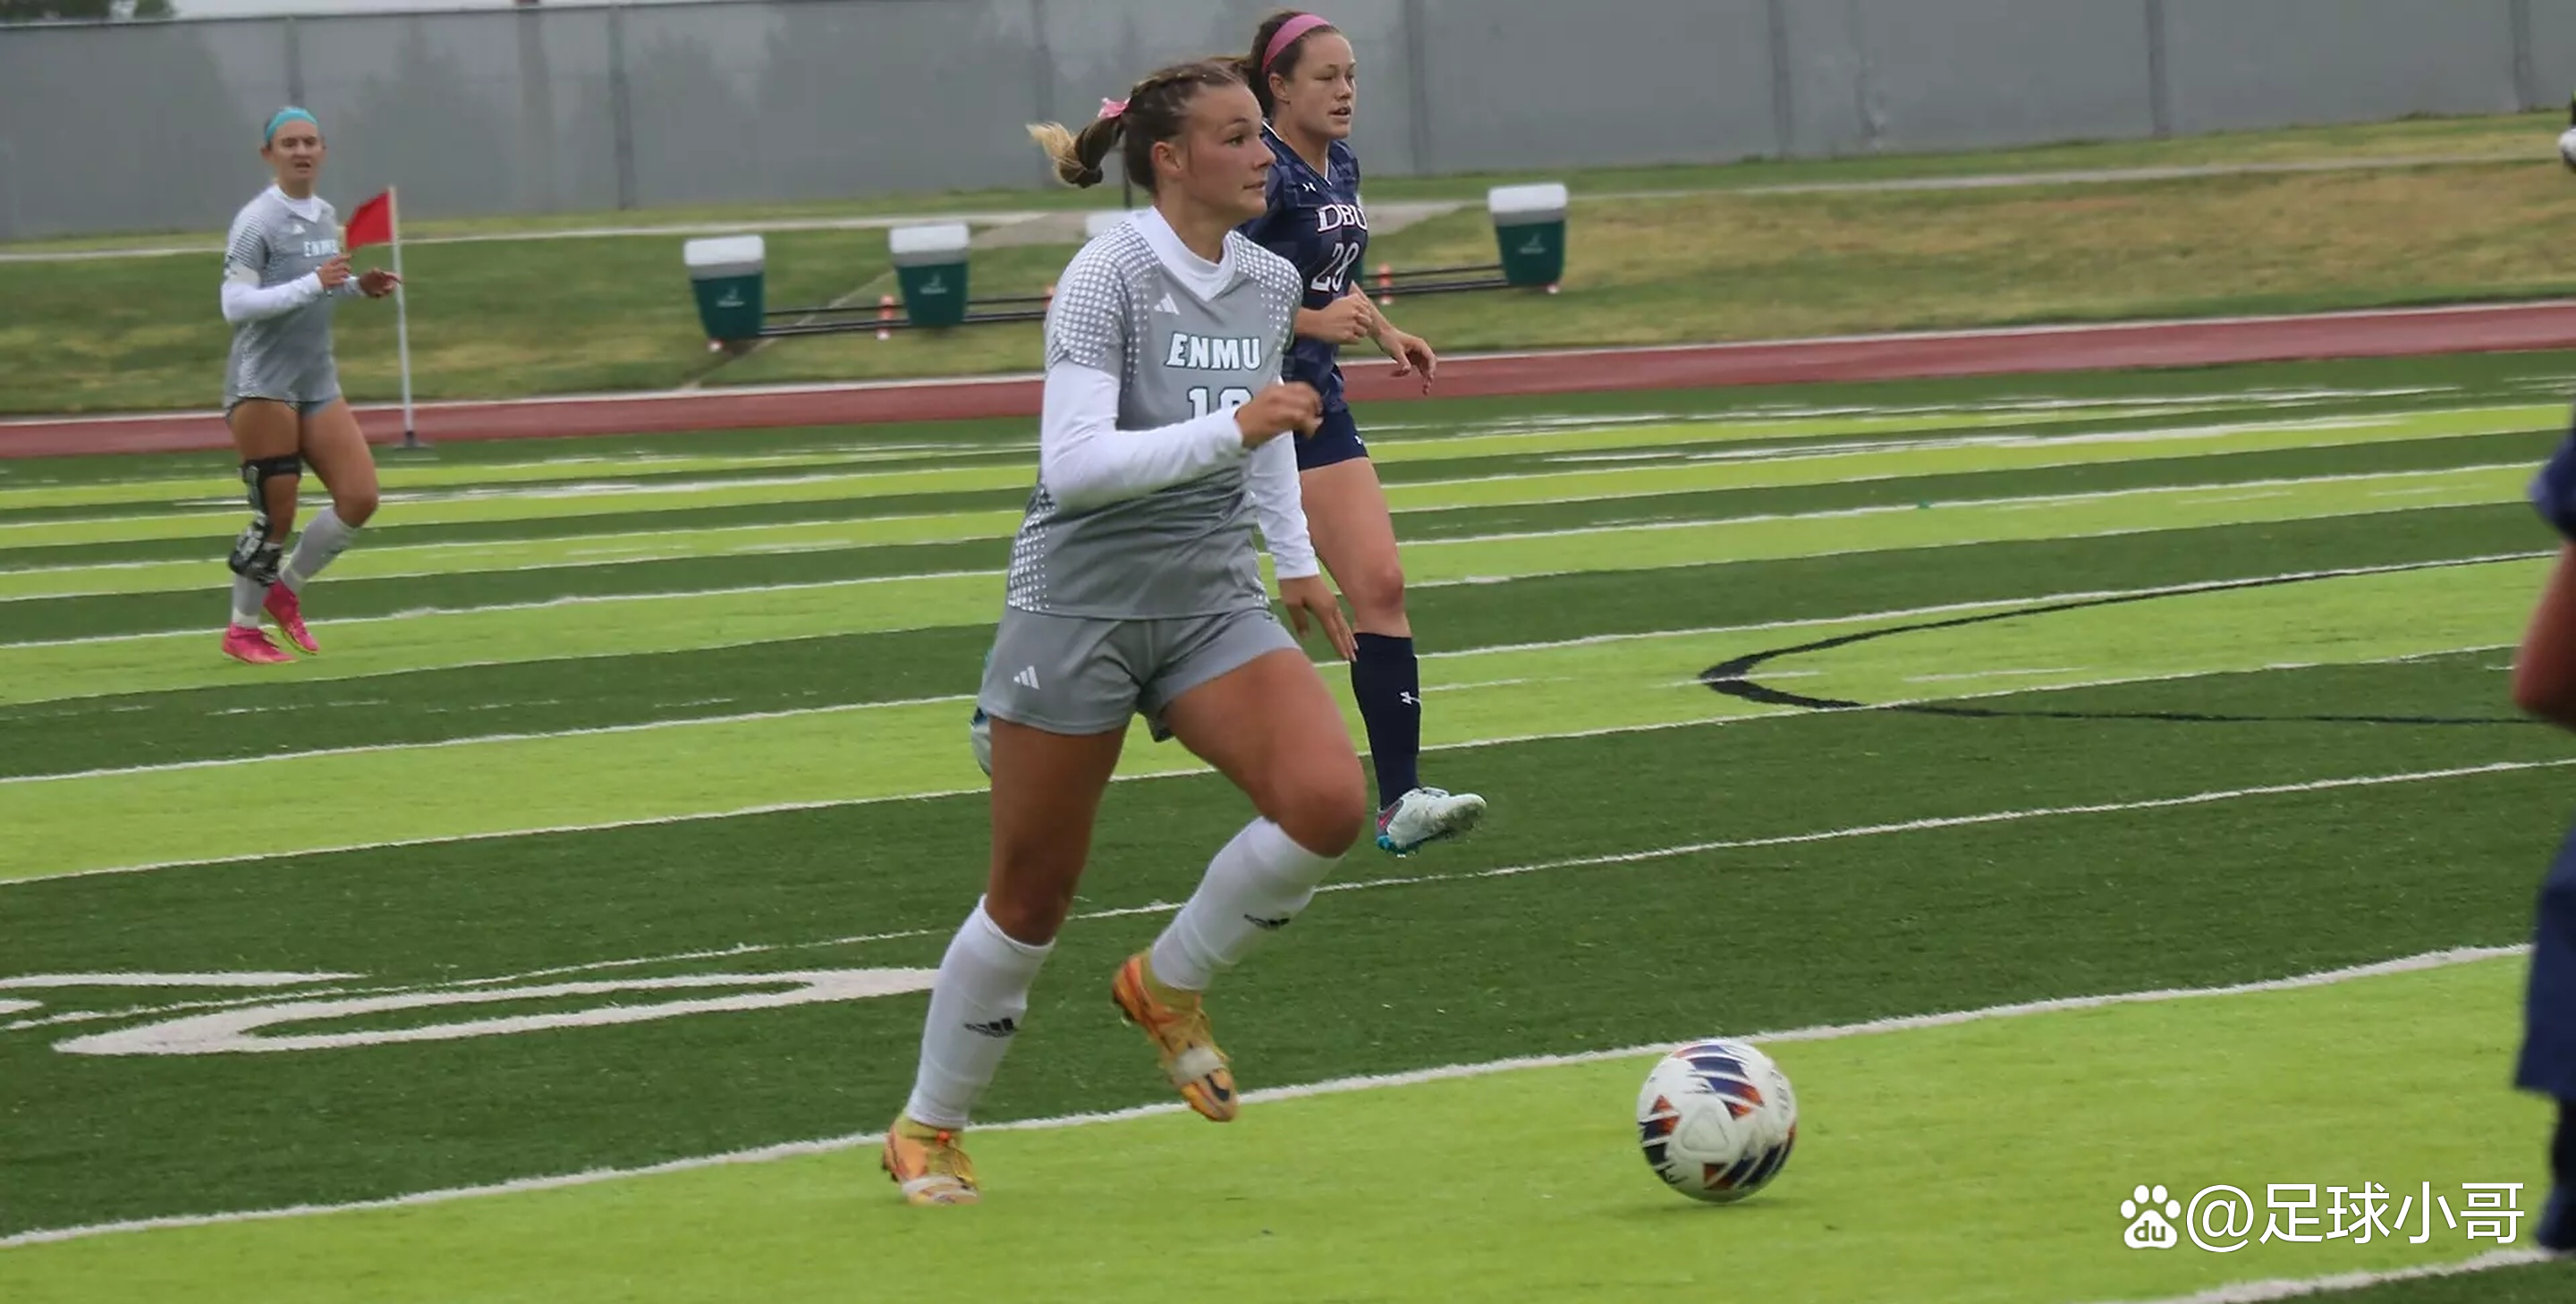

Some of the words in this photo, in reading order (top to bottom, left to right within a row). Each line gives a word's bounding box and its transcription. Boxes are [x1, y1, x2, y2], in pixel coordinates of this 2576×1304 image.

[1317, 204, 1368, 232] DBU
[1310, 241, 1360, 292] 28
[1165, 331, 1261, 369] ENMU
